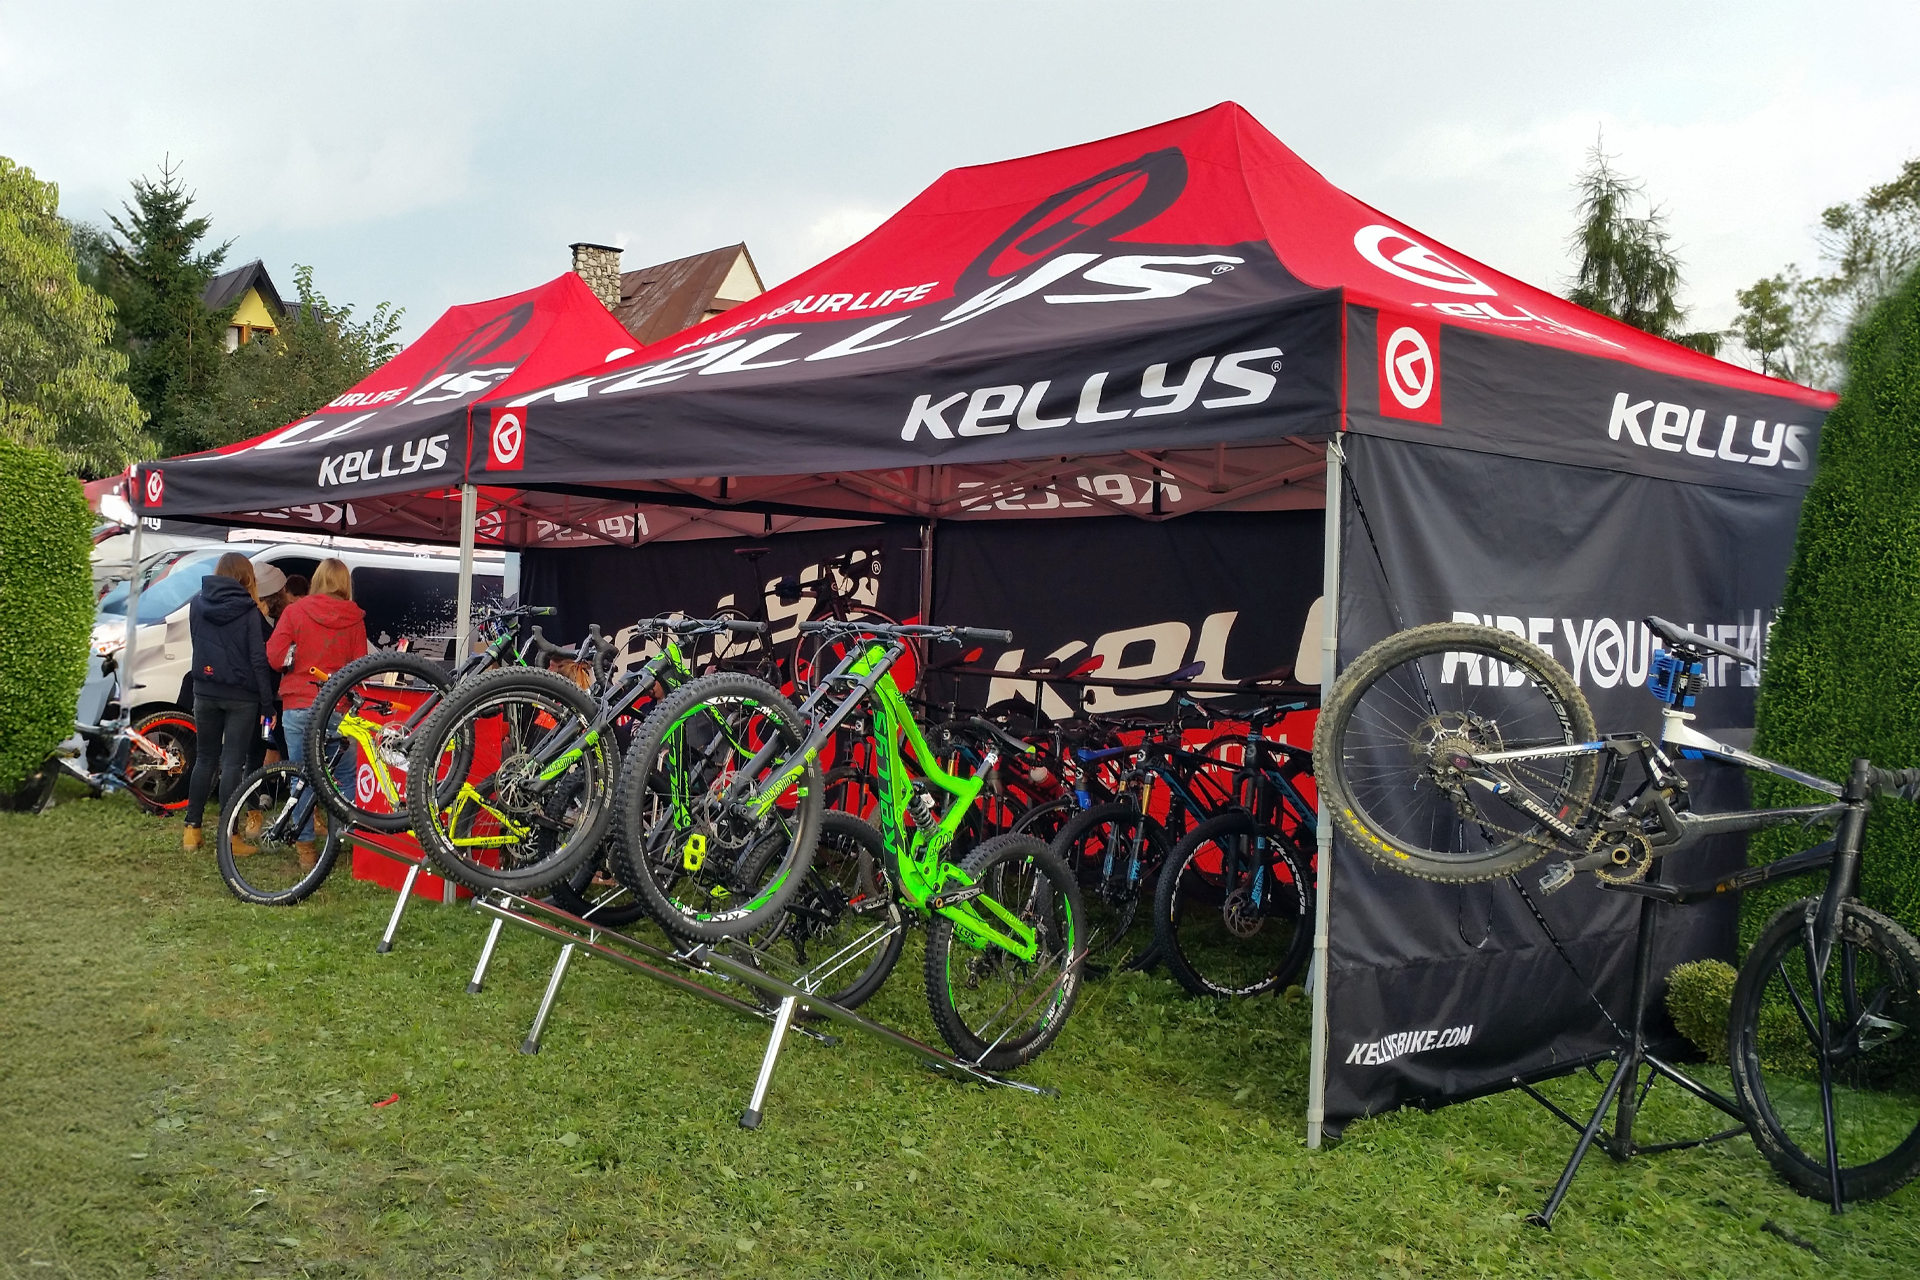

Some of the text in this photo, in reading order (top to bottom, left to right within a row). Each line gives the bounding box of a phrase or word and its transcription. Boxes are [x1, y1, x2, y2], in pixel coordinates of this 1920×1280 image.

[848, 281, 940, 312] LIFE
[361, 386, 409, 406] LIFE
[900, 346, 1284, 442] KELLYS
[1607, 391, 1811, 471] KELLYS
[317, 433, 450, 488] KELLYS
[1440, 611, 1555, 689] RIDE
[872, 709, 897, 855] KELLYS
[1343, 808, 1411, 861] MAXXIS
[1522, 798, 1575, 838] RENTHAL
[1345, 1024, 1474, 1066] KELLYSBIKE.COM
